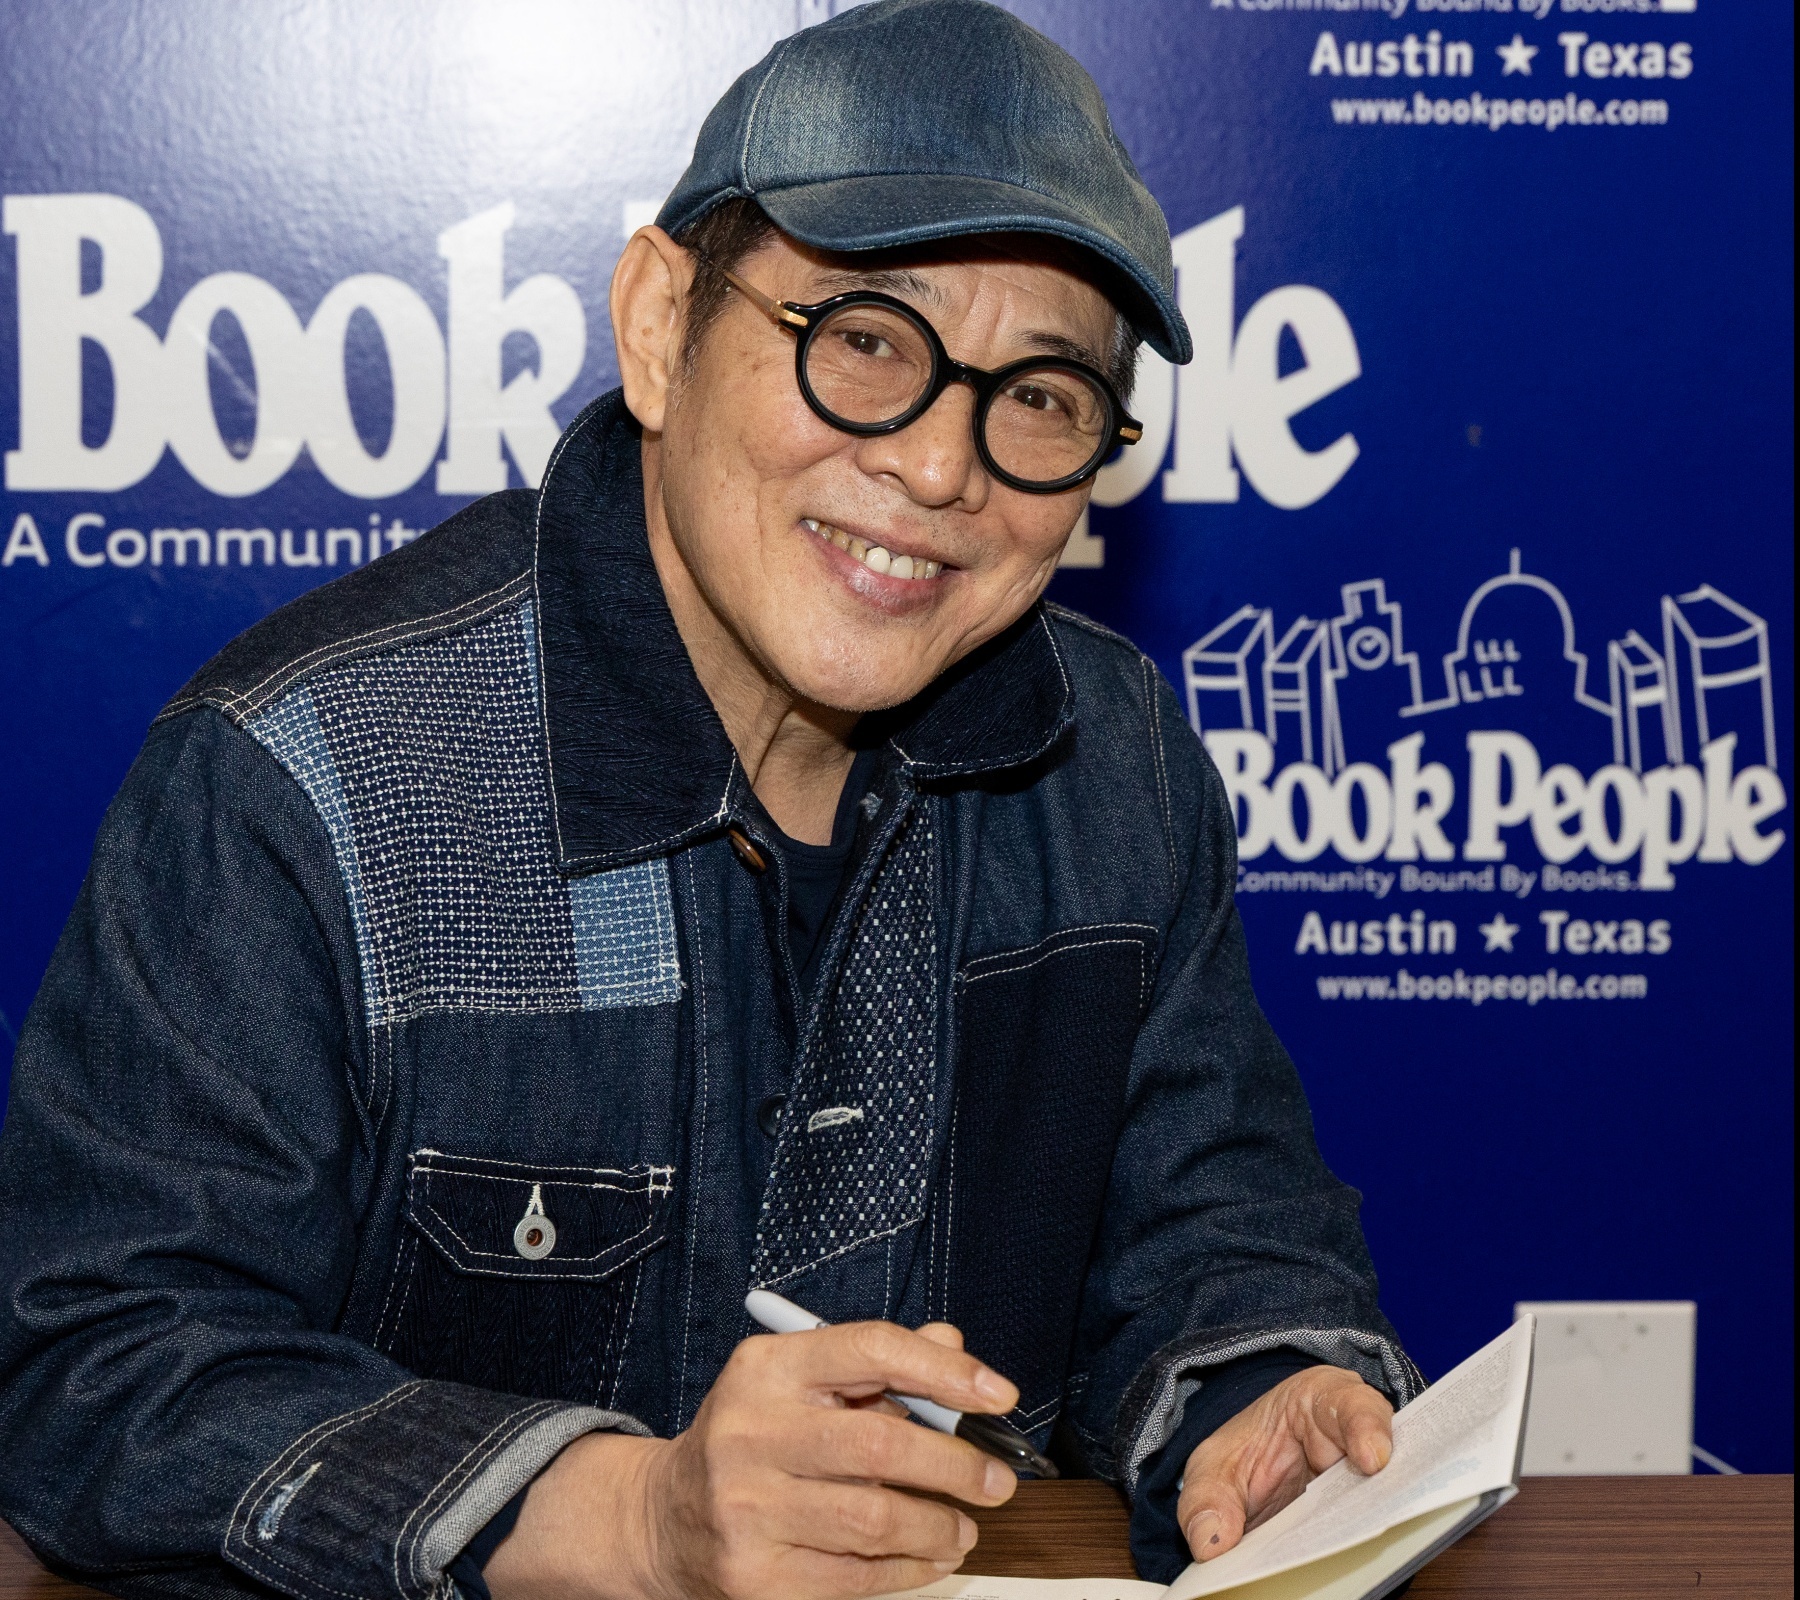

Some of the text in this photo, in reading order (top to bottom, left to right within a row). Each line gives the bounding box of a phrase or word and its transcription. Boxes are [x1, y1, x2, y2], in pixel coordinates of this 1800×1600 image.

[1308, 30, 1694, 79] Austin Texas
[1330, 91, 1669, 131] www.bookpeople.com
[3, 193, 586, 498] Book
[1, 512, 424, 568] A Communit
[1203, 729, 1786, 891] Book People
[1400, 865, 1495, 892] Bound
[1500, 865, 1537, 898] By
[1295, 909, 1672, 956] Austin Texas
[1316, 968, 1648, 1005] www.bookpeople.com
